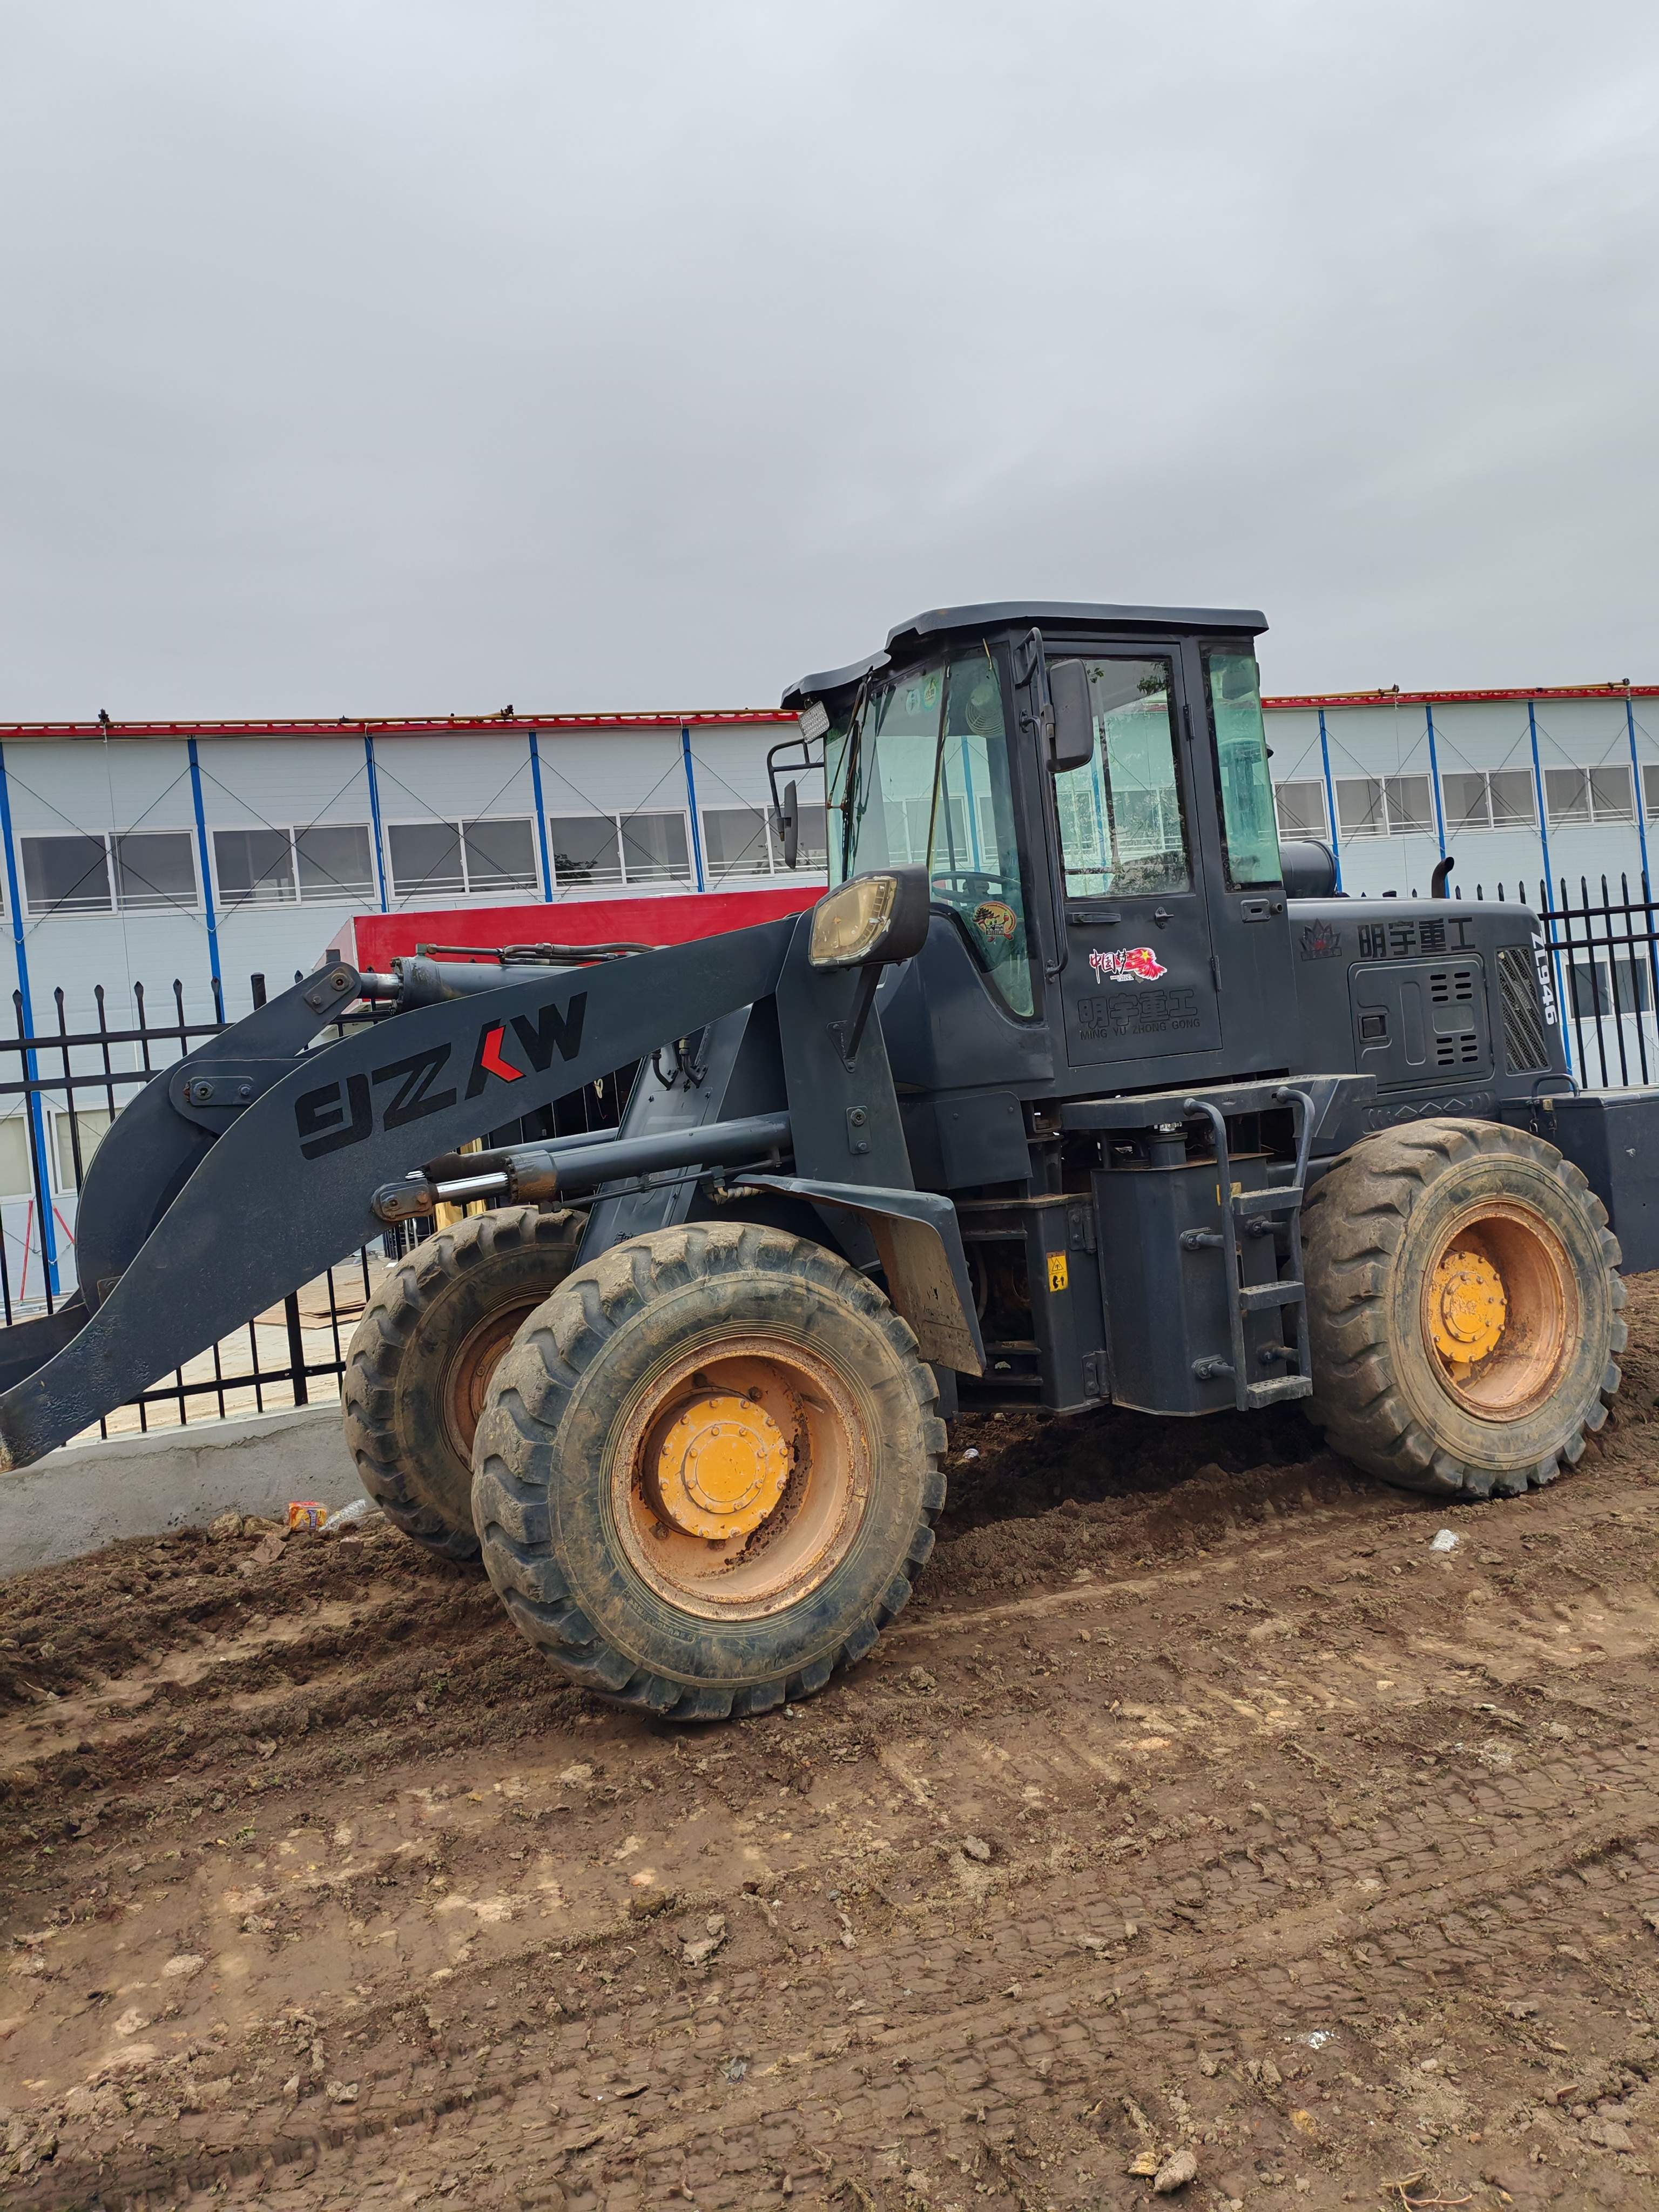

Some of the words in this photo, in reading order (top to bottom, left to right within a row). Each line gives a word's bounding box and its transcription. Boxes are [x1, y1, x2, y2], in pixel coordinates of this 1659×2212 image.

[1358, 918, 1475, 958] 明宇重工
[1089, 948, 1127, 983] 中国梦
[1530, 930, 1557, 1026] ZL946
[1078, 989, 1198, 1029] 明宇重工
[1081, 1029, 1107, 1040] MING
[1113, 1026, 1127, 1036] YU
[1133, 1022, 1166, 1034] ZHONG
[1172, 1019, 1201, 1030] GONG
